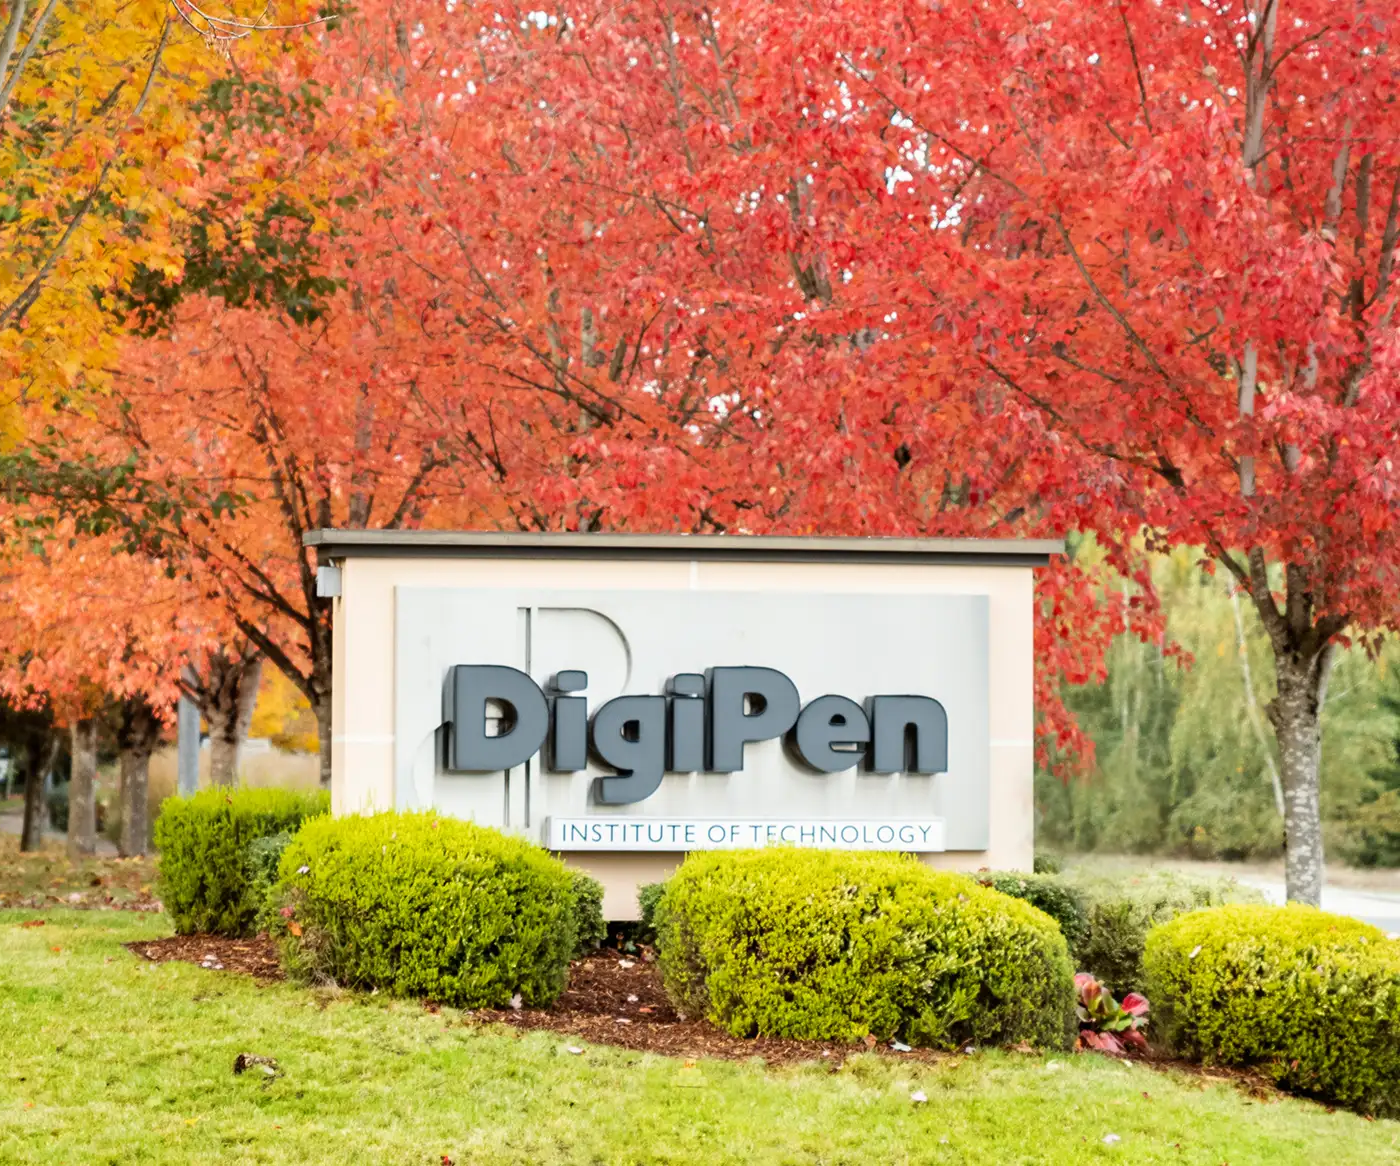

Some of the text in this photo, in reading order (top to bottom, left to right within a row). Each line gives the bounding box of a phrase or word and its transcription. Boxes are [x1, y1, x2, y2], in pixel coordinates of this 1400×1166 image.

[444, 664, 948, 804] DigiPen
[562, 824, 933, 844] INSTITUTE OF TECHNOLOGY
